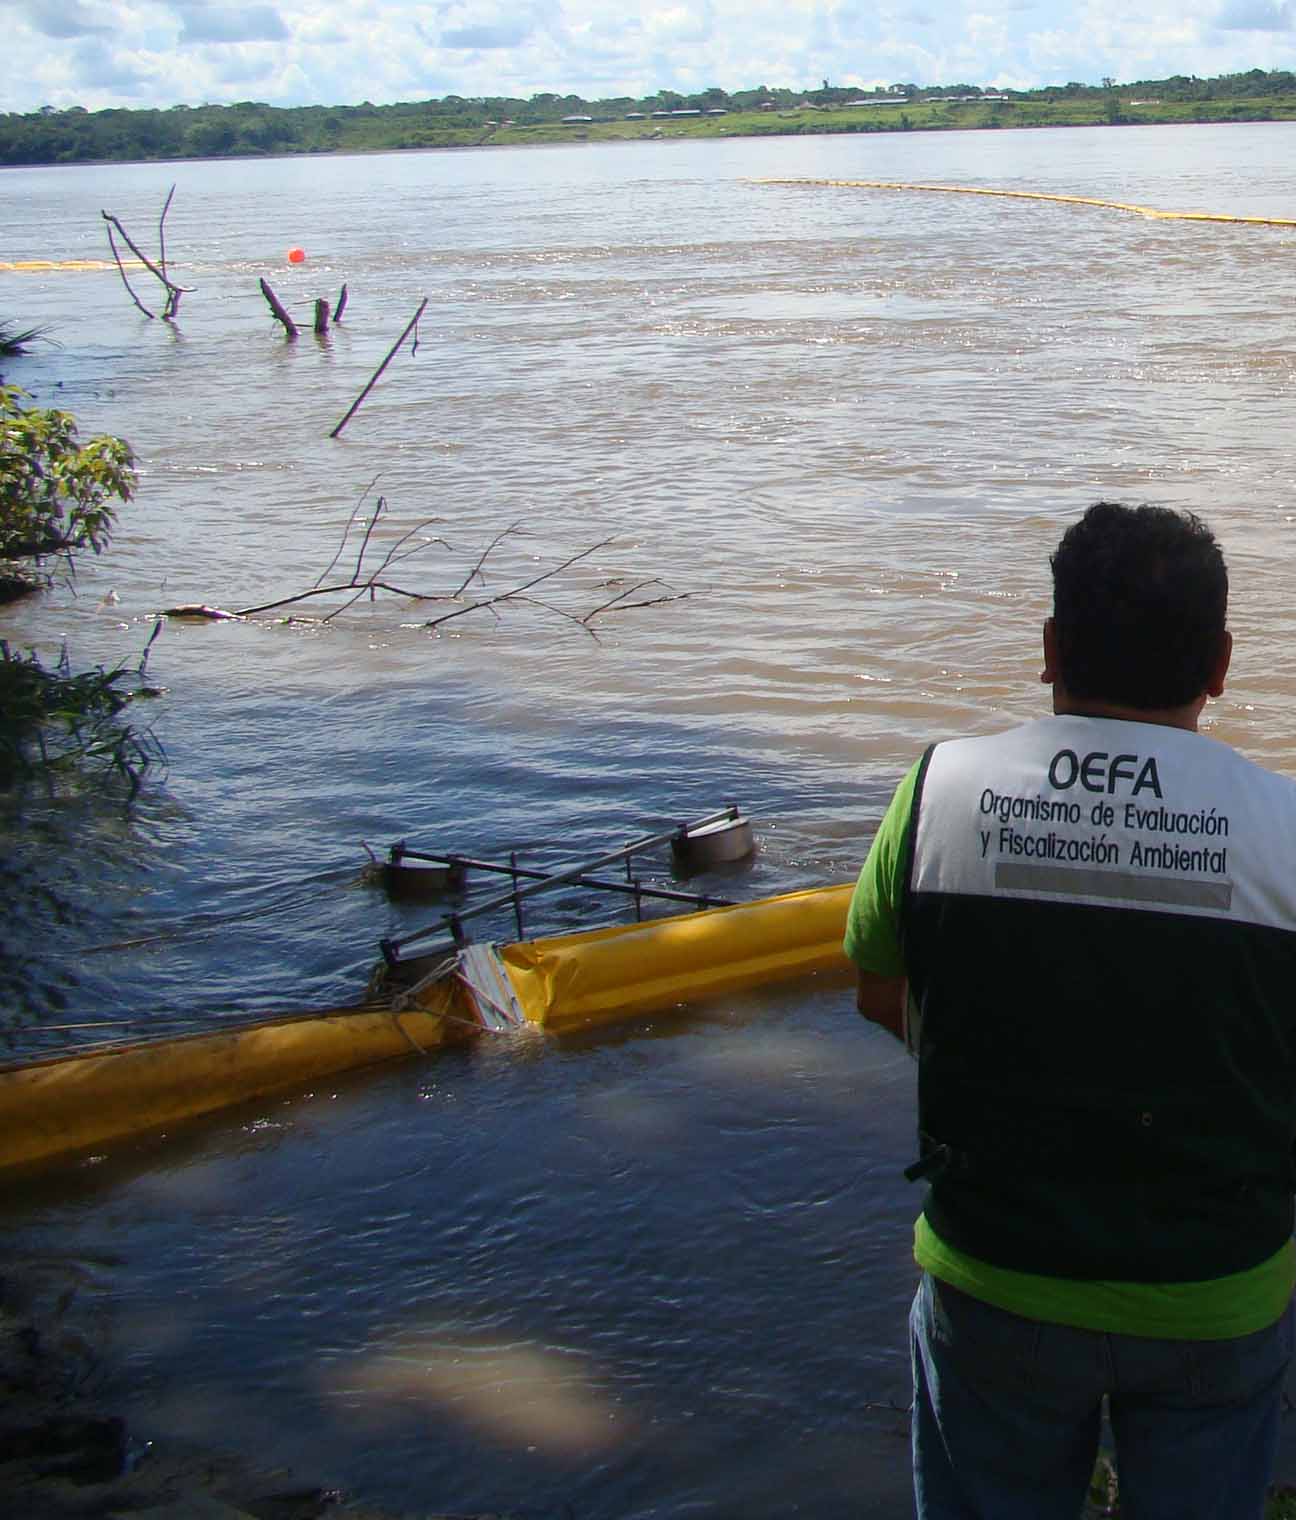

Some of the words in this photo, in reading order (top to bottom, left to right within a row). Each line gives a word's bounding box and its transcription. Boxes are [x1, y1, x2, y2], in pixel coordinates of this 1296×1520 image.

[1047, 748, 1163, 799] OEFA
[980, 788, 1081, 824] Organismo
[1090, 801, 1115, 828] de
[1124, 804, 1229, 837] Evaluación
[980, 830, 991, 858] y
[1000, 828, 1119, 864] Fiscalización
[1129, 841, 1227, 874] Ambiental
